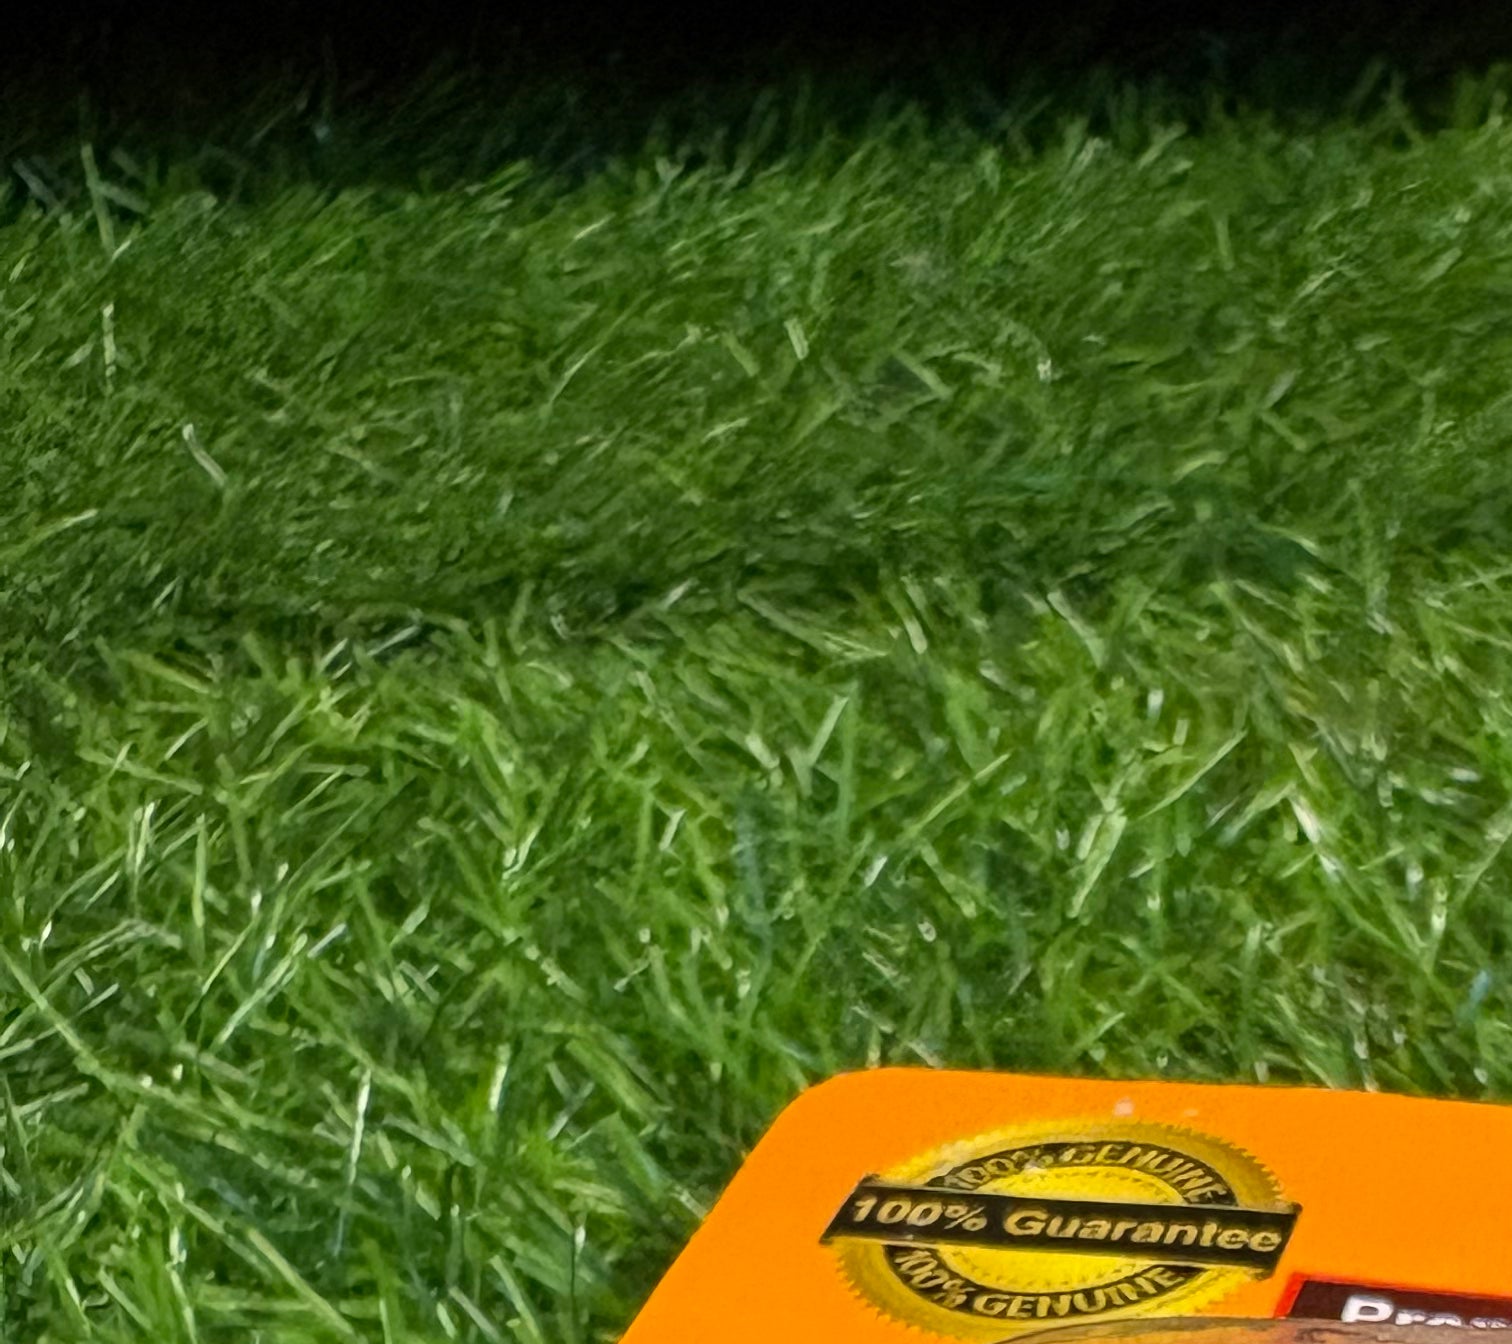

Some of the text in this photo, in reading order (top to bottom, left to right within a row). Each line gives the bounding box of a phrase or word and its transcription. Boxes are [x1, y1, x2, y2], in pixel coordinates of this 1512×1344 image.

[852, 1195, 1284, 1253] 100% Guarantee
[971, 1265, 1187, 1321] GENUINE
